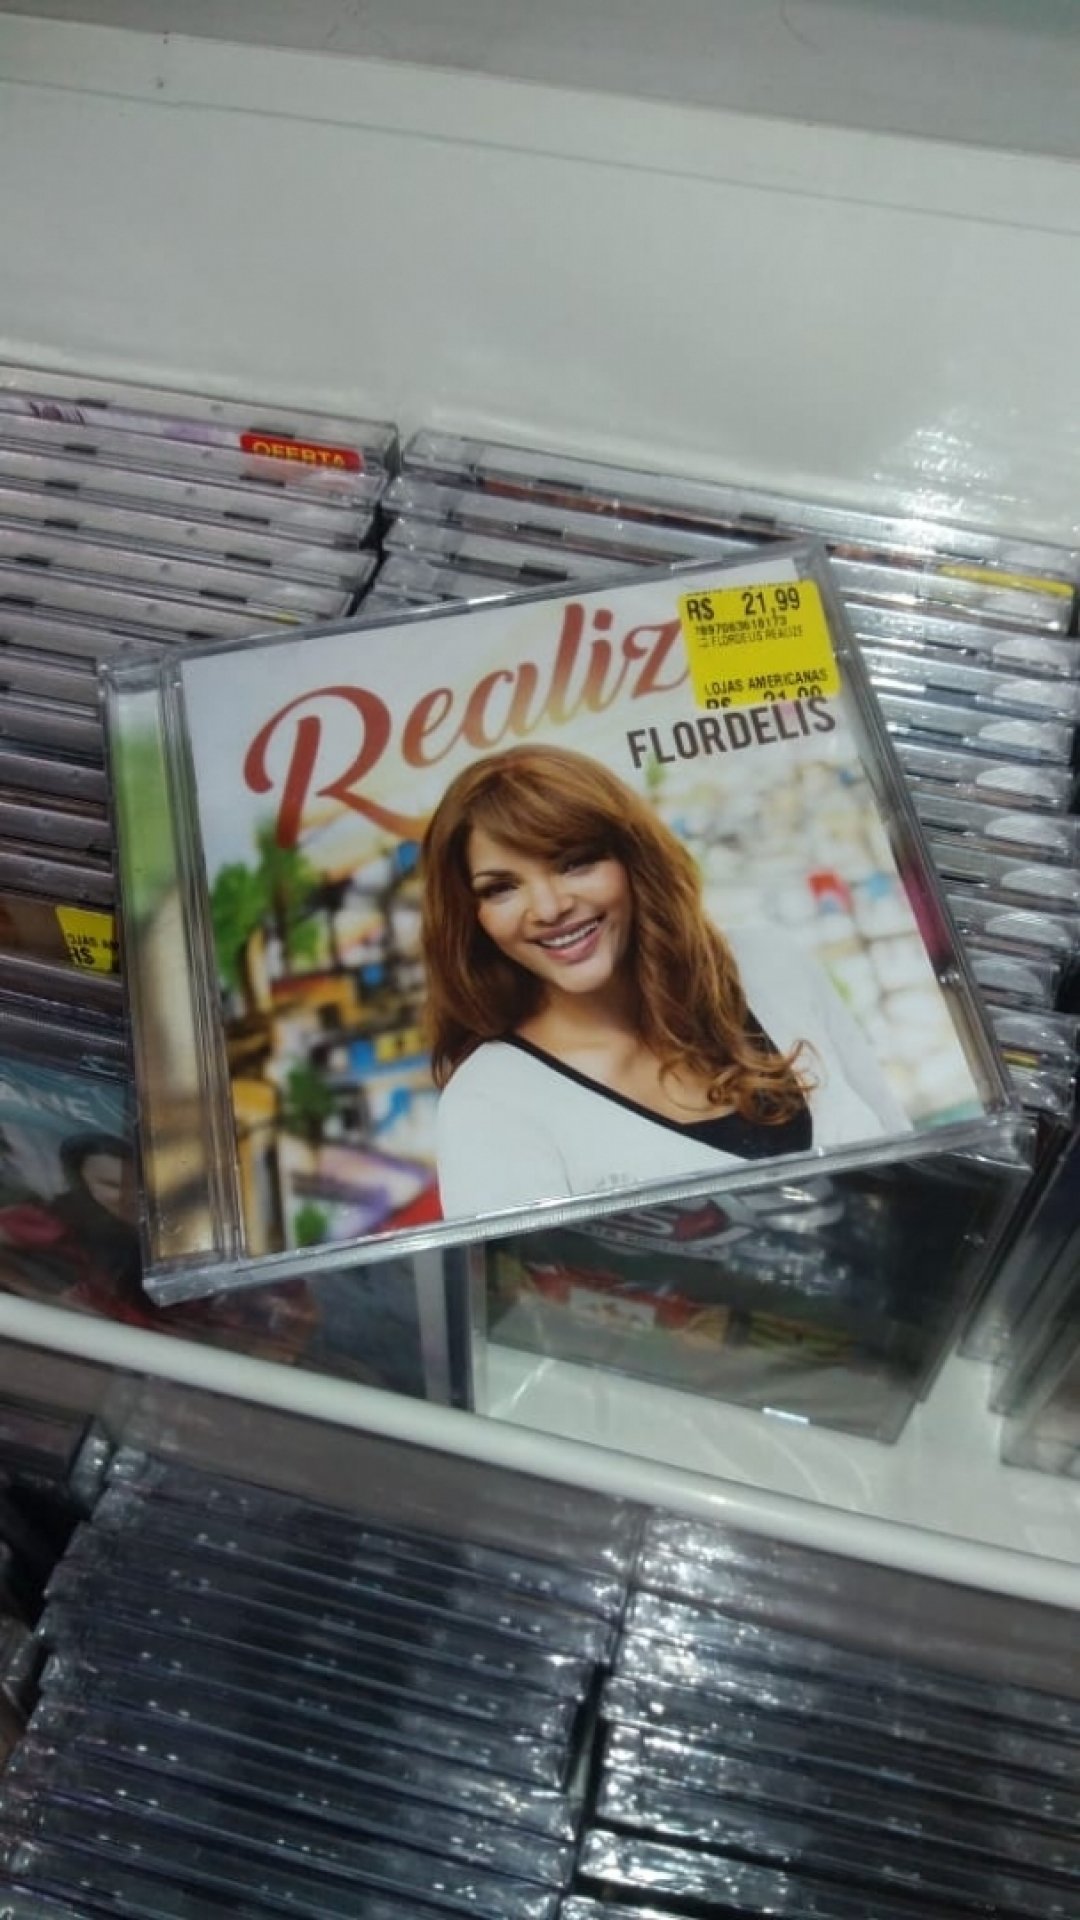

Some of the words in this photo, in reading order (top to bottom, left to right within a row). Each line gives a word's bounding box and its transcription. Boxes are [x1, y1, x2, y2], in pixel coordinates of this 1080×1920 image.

[741, 587, 801, 618] 21,99
[705, 678, 743, 696] LOJAS
[748, 668, 829, 689] AMERICANAS
[243, 603, 690, 849] Realiz
[627, 696, 836, 768] FLORDELIS
